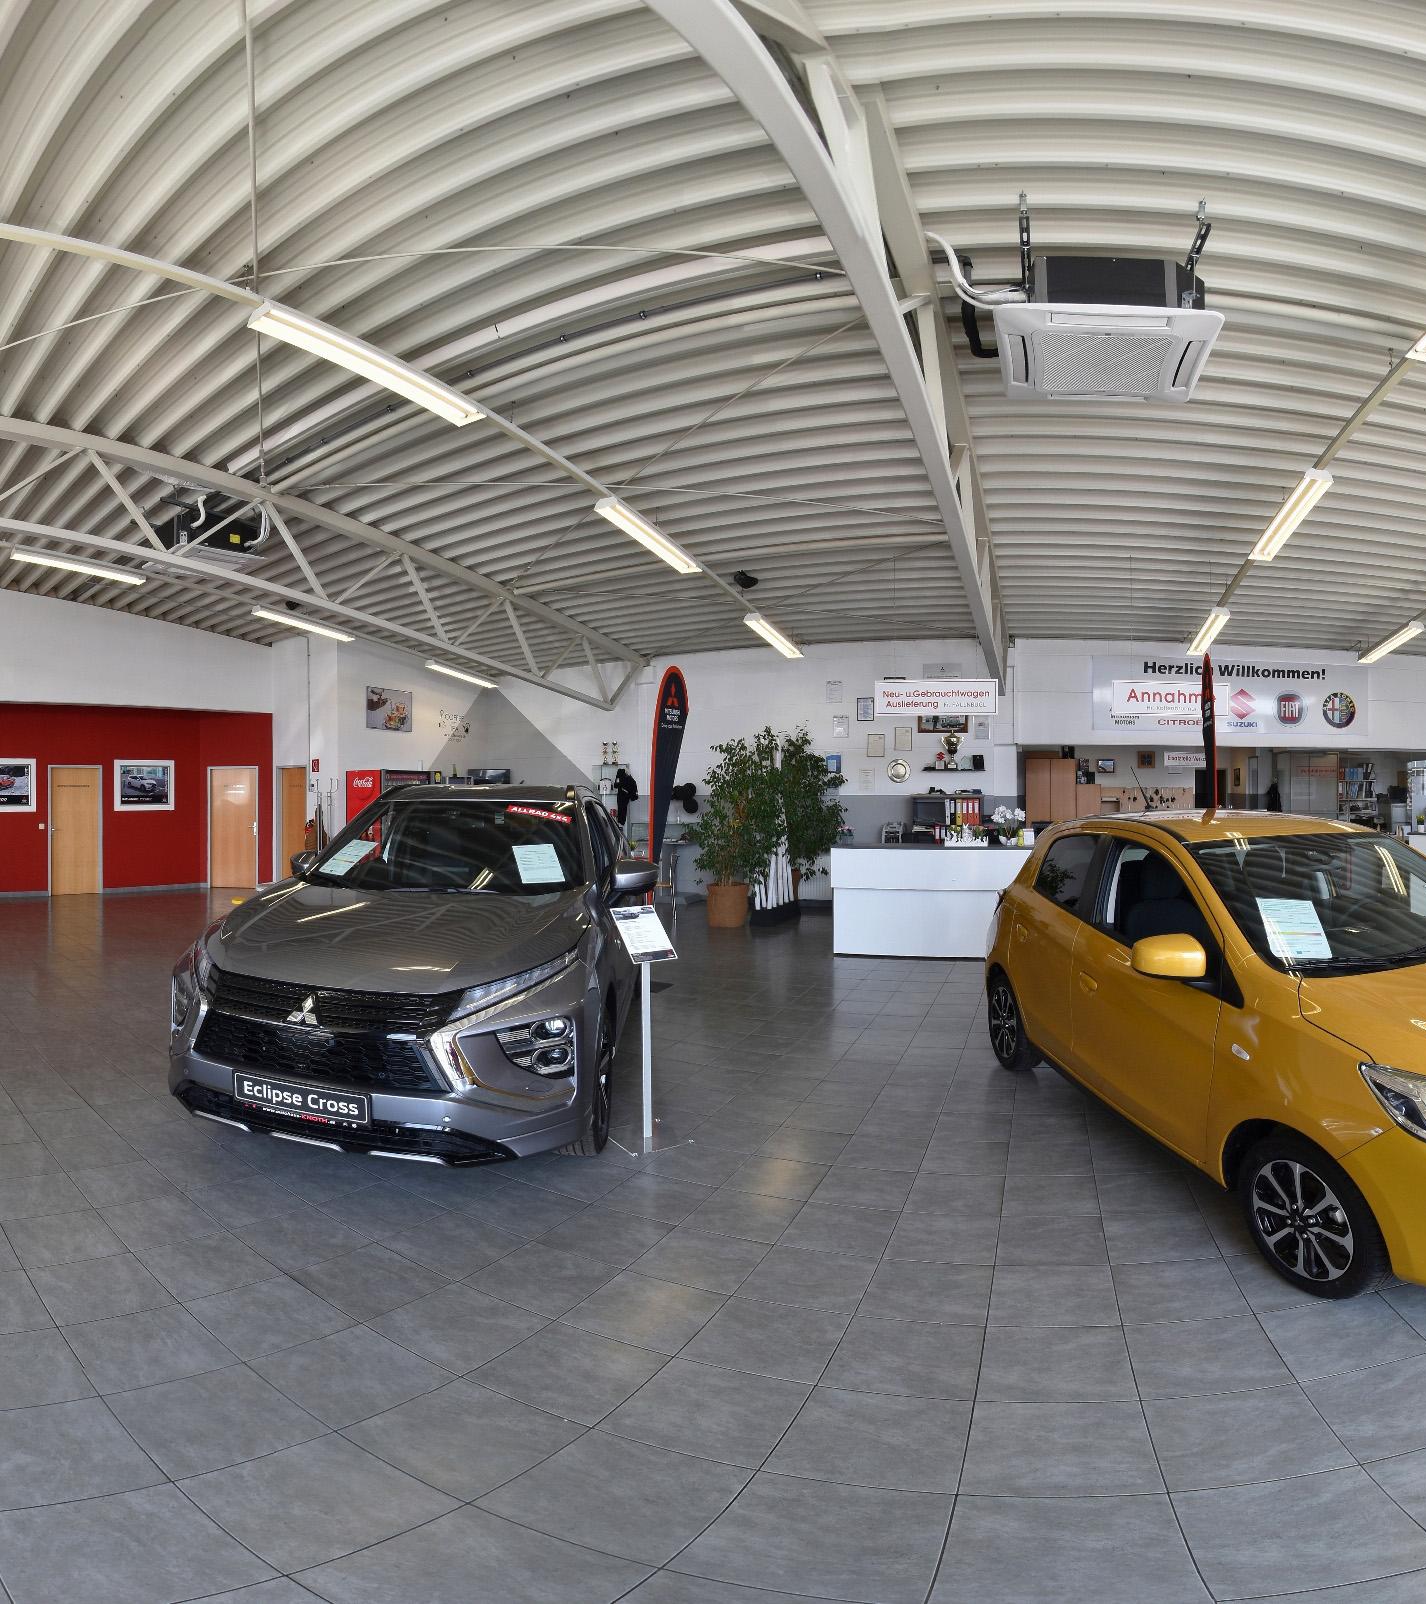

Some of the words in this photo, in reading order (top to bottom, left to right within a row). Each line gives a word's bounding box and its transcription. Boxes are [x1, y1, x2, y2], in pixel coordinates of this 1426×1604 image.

[1143, 661, 1214, 676] Herzlic
[1218, 664, 1326, 680] Willkommen!
[882, 690, 903, 699] Neu-
[1126, 688, 1216, 704] Annahm
[886, 701, 939, 710] Auslieferung
[1280, 701, 1300, 718] FIAT
[1157, 718, 1204, 726] CITROË
[511, 806, 549, 817] ALLRAD
[243, 1080, 303, 1106] Eclipse
[307, 1094, 359, 1116] Cross
